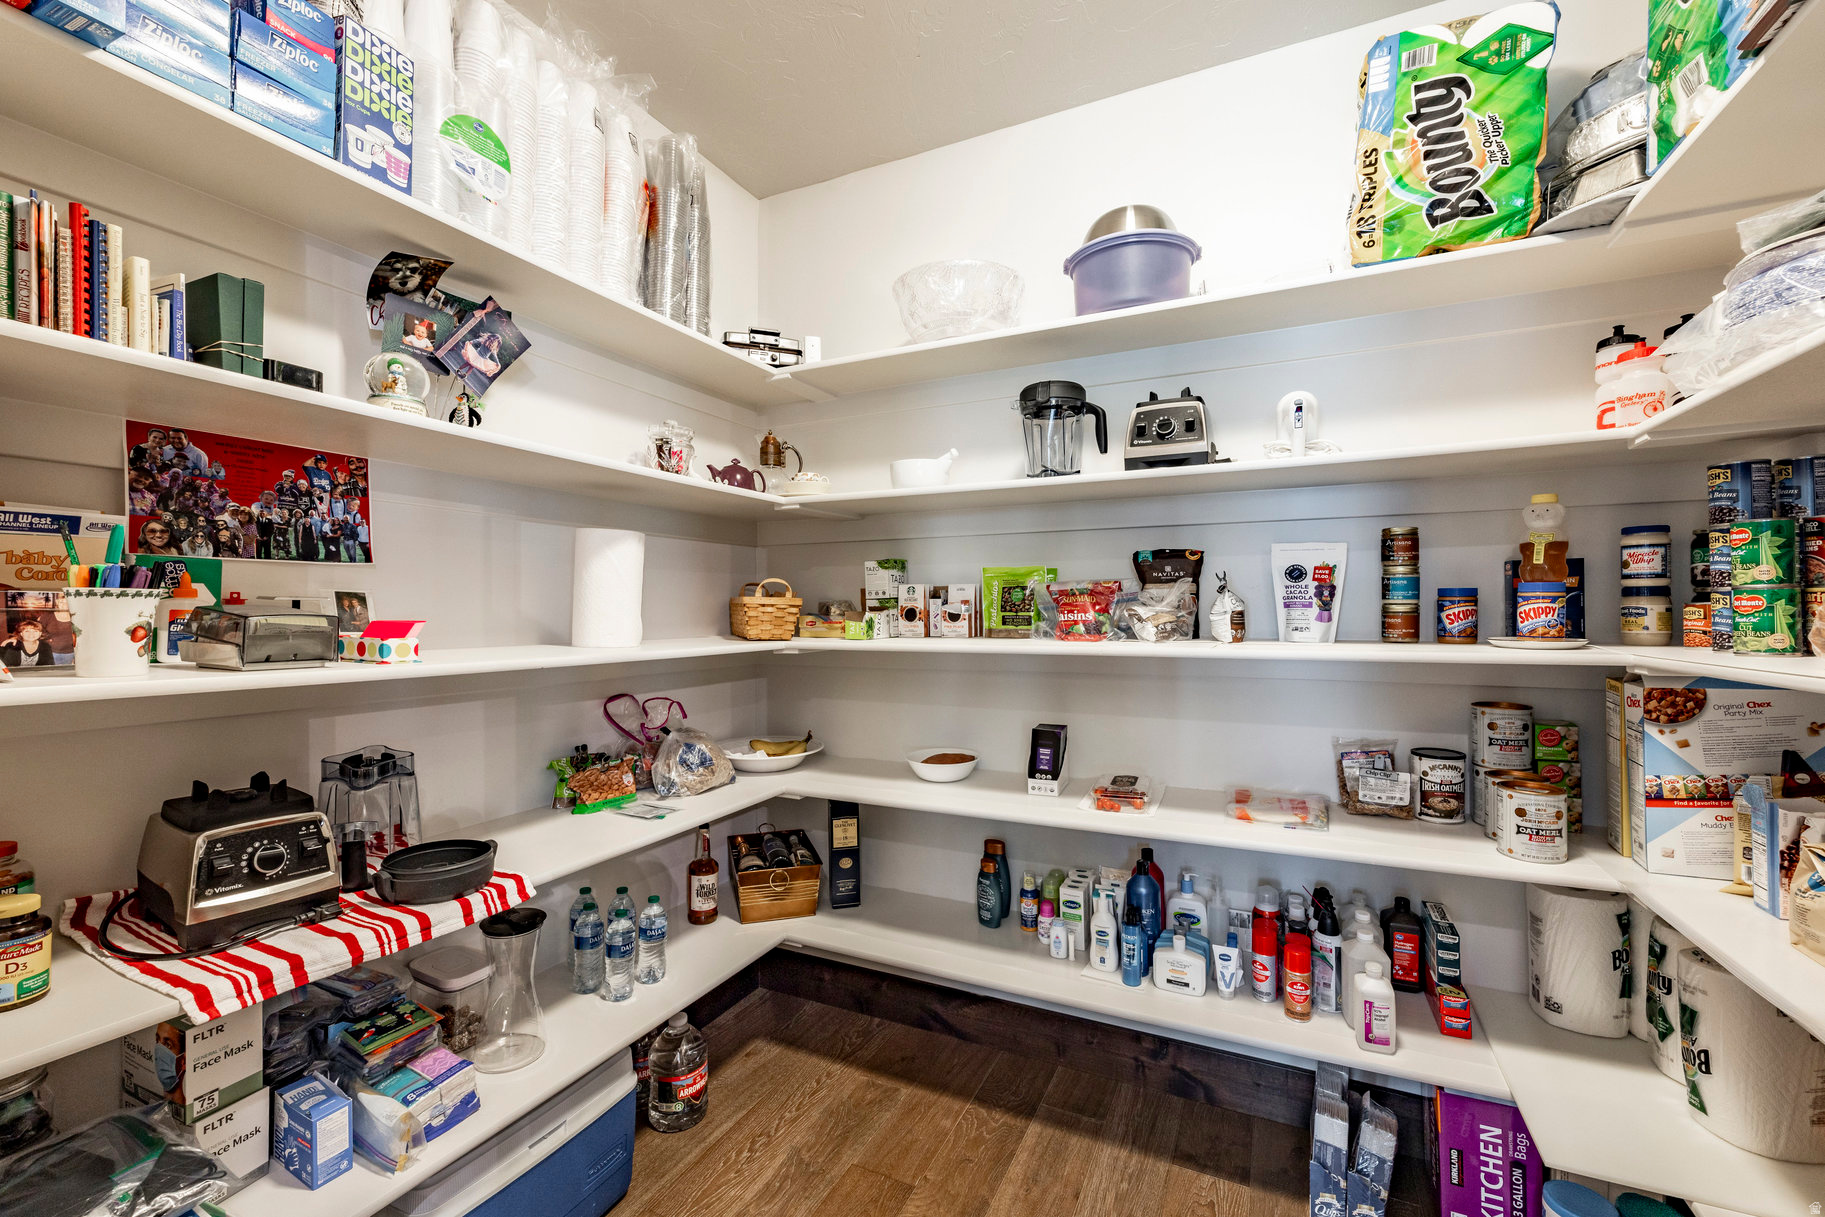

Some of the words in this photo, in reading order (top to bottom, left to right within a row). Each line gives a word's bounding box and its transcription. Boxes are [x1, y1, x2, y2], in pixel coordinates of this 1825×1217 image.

[269, 19, 297, 39] SNACK
[141, 18, 204, 63] Ziploc
[239, 48, 277, 72] FREEZER
[271, 34, 320, 73] Ziploc
[141, 52, 197, 84] CONGELAR
[237, 102, 275, 122] FREEZER
[1477, 118, 1493, 148] Quicker
[1491, 114, 1505, 138] Upper
[1404, 73, 1498, 232] Bounty
[1489, 147, 1500, 164] The
[1494, 137, 1511, 166] Picker
[1361, 147, 1379, 212] TRIPLES
[18, 269, 30, 310] RECIPES
[18, 514, 52, 525] West
[1, 550, 69, 568] baby
[1626, 549, 1660, 560] Miracle
[1629, 557, 1655, 565] Whip
[1713, 554, 1732, 562] Bean
[990, 580, 999, 628] Pistachios
[1518, 606, 1558, 625] SKIPPY
[1626, 696, 1642, 708] Chex
[1712, 701, 1745, 711] Original
[1746, 701, 1773, 709] Chex
[1365, 769, 1378, 777] Chip
[1421, 779, 1440, 791] IRISH
[1700, 822, 1727, 830] Muddy
[1714, 814, 1734, 822] Che
[1519, 827, 1537, 835] OAT
[213, 883, 243, 894] Vitamix
[700, 882, 716, 891] WILD
[5, 962, 28, 975] D3
[193, 1024, 225, 1044] FLTR
[123, 1037, 136, 1051] Face
[193, 1055, 222, 1073] Face
[224, 1040, 254, 1059] Mask
[199, 1095, 215, 1109] 75
[290, 1086, 317, 1102] HAND
[407, 1092, 417, 1102] 8
[196, 1103, 217, 1114] MASKS
[203, 1112, 234, 1135] FLTR
[212, 1145, 230, 1157] ace
[233, 1126, 261, 1147] Mask
[1514, 1132, 1530, 1160] Bags
[1450, 1149, 1458, 1185] KIRKLAND
[1480, 1124, 1504, 1217] KITCHEN
[1513, 1168, 1524, 1209] GALLON
